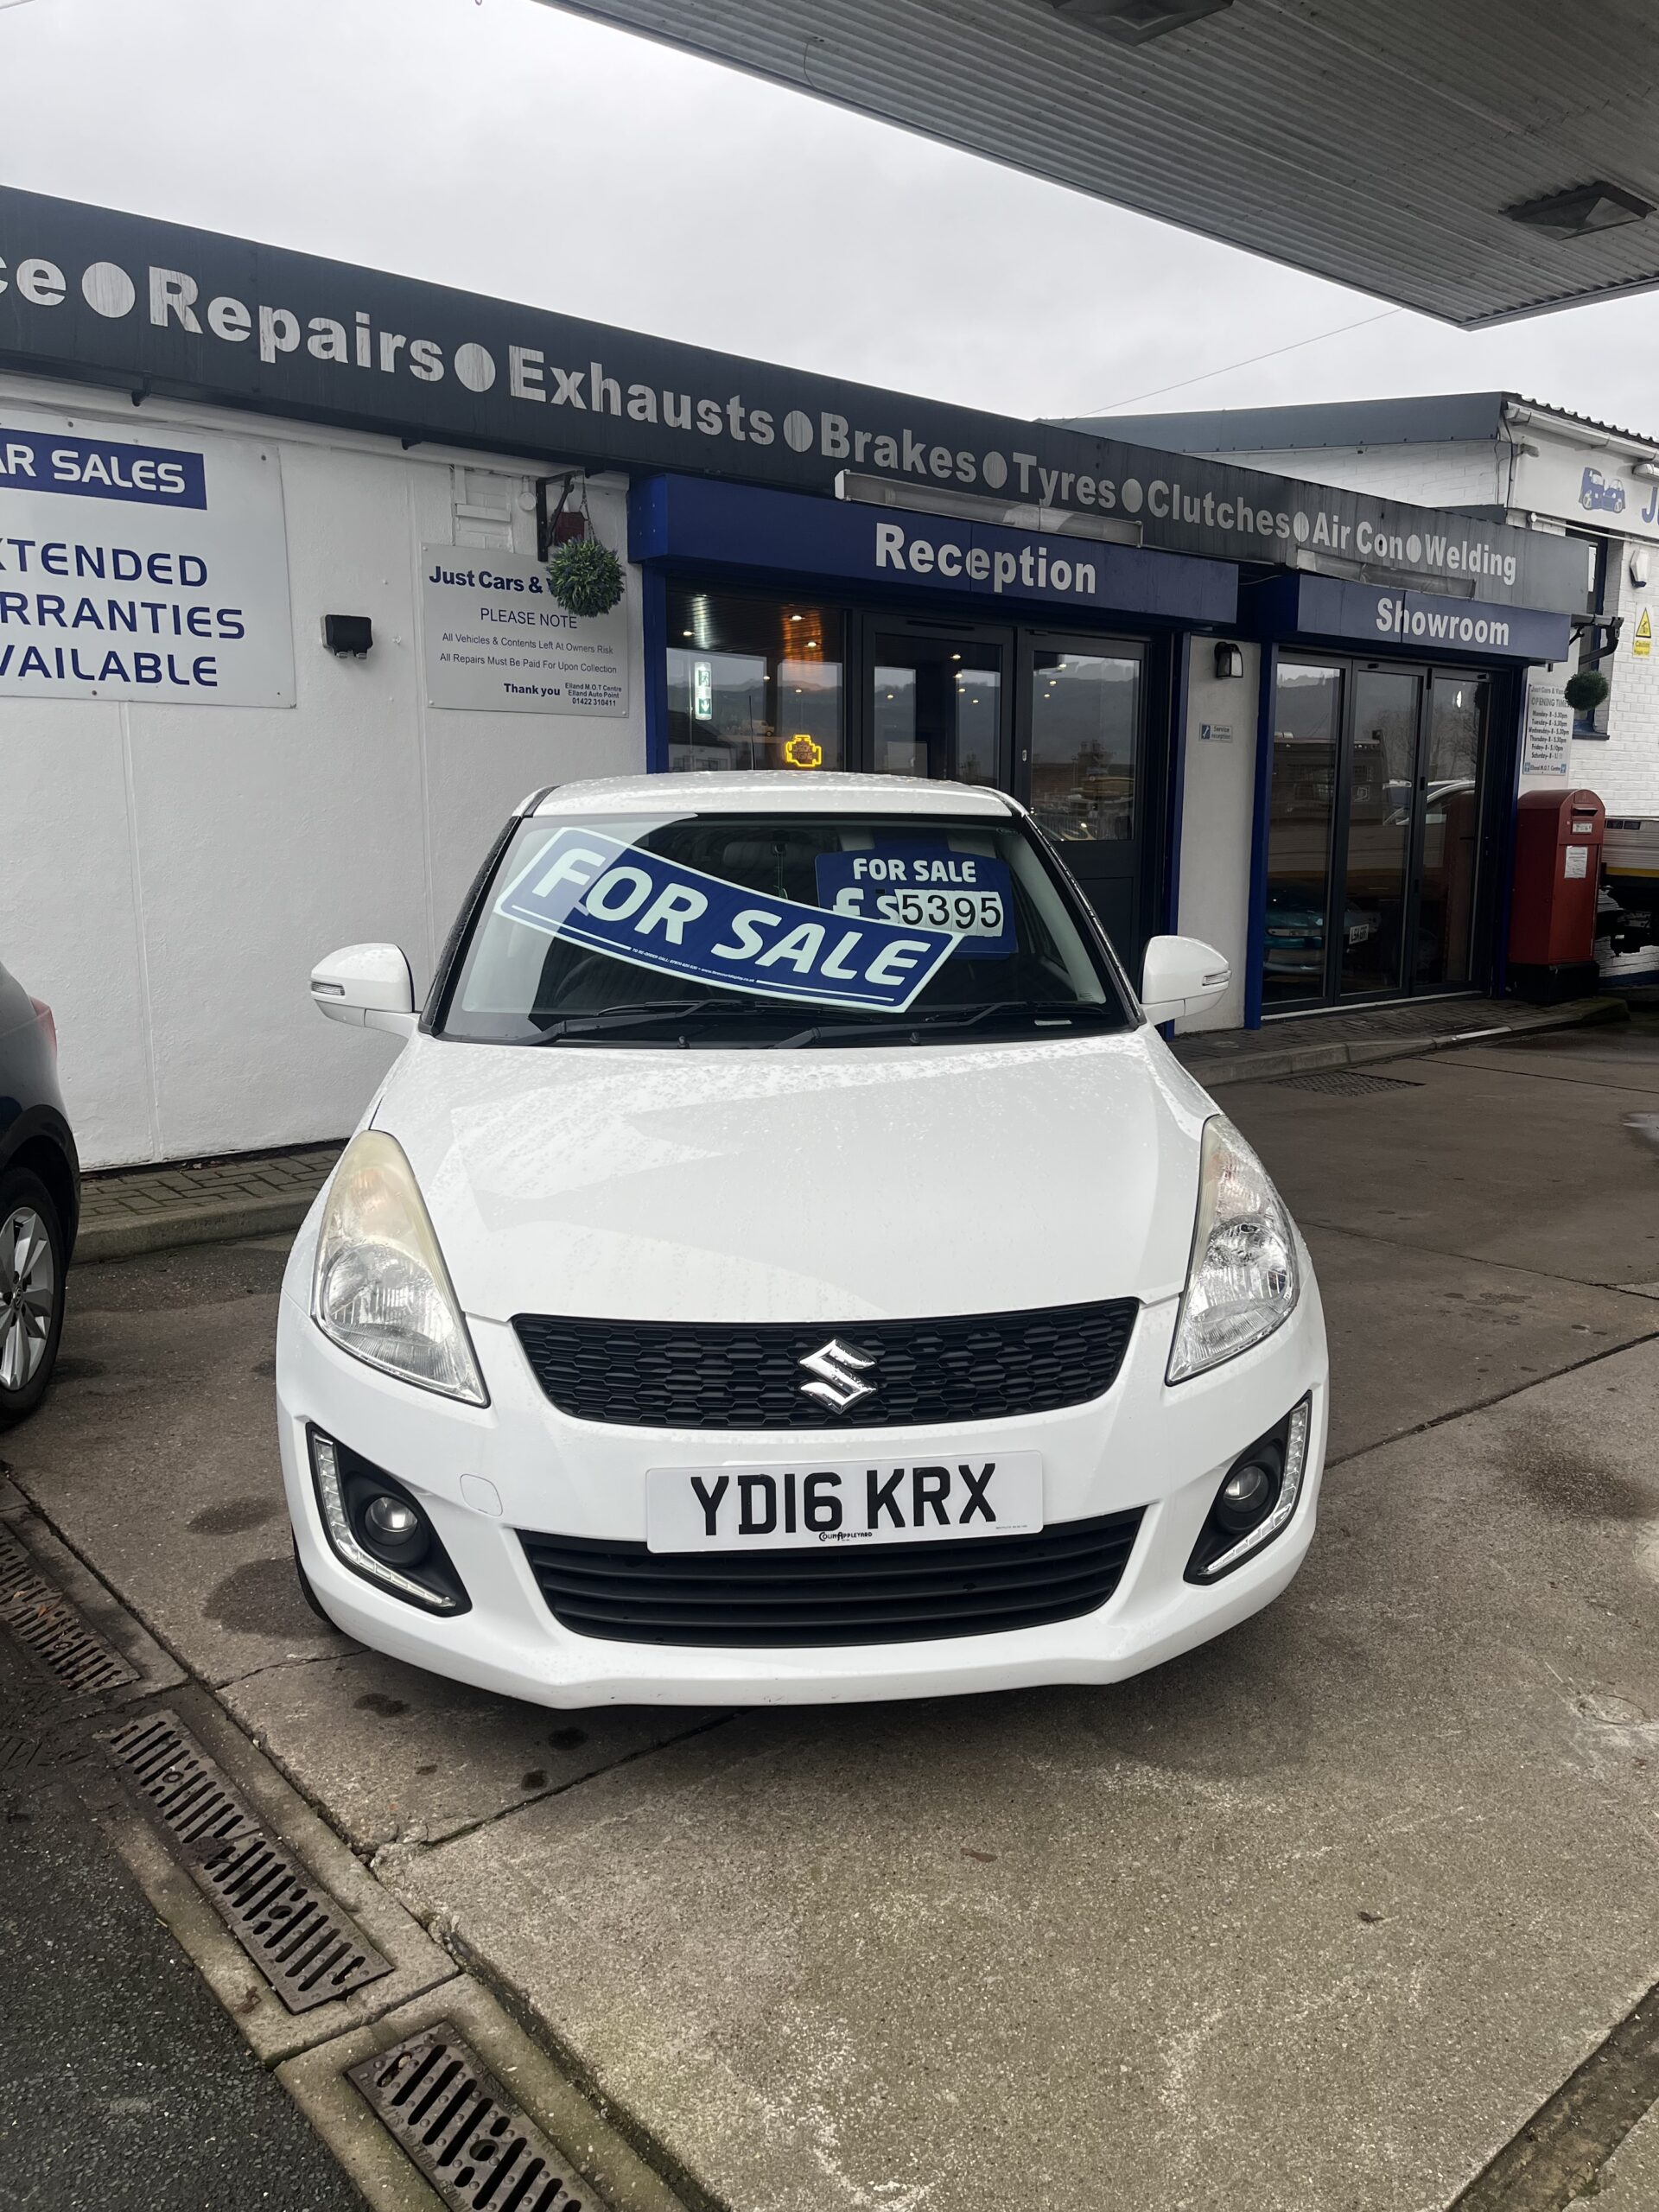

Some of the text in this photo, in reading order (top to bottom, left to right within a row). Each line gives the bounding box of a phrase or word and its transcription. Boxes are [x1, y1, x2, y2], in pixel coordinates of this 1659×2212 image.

[0, 256, 1517, 586] e Repairs Exhausts Brakes Tyres Clutches Air Con Welding
[0, 443, 186, 493] R SALES
[0, 537, 207, 587] TENDED
[876, 522, 1096, 594] Reception
[429, 566, 475, 588] Just
[479, 571, 524, 593] Cars
[528, 576, 543, 594] &
[480, 607, 578, 629] PLEASE NOTE
[1376, 597, 1510, 646] Showroom
[442, 632, 613, 655] All Vehicles & Contents Left At Owners Risk
[440, 652, 617, 674] All Repairs Must Be Paid For Upon Collection
[504, 683, 561, 697] Thank you
[593, 698, 616, 707] 310411
[603, 690, 620, 699] Point
[1531, 696, 1555, 707] OPENING
[853, 858, 977, 883] FOR SALE
[532, 848, 932, 986] FOR SALE
[901, 894, 1001, 929] 5395
[690, 1463, 996, 1535] YD16 KRX
